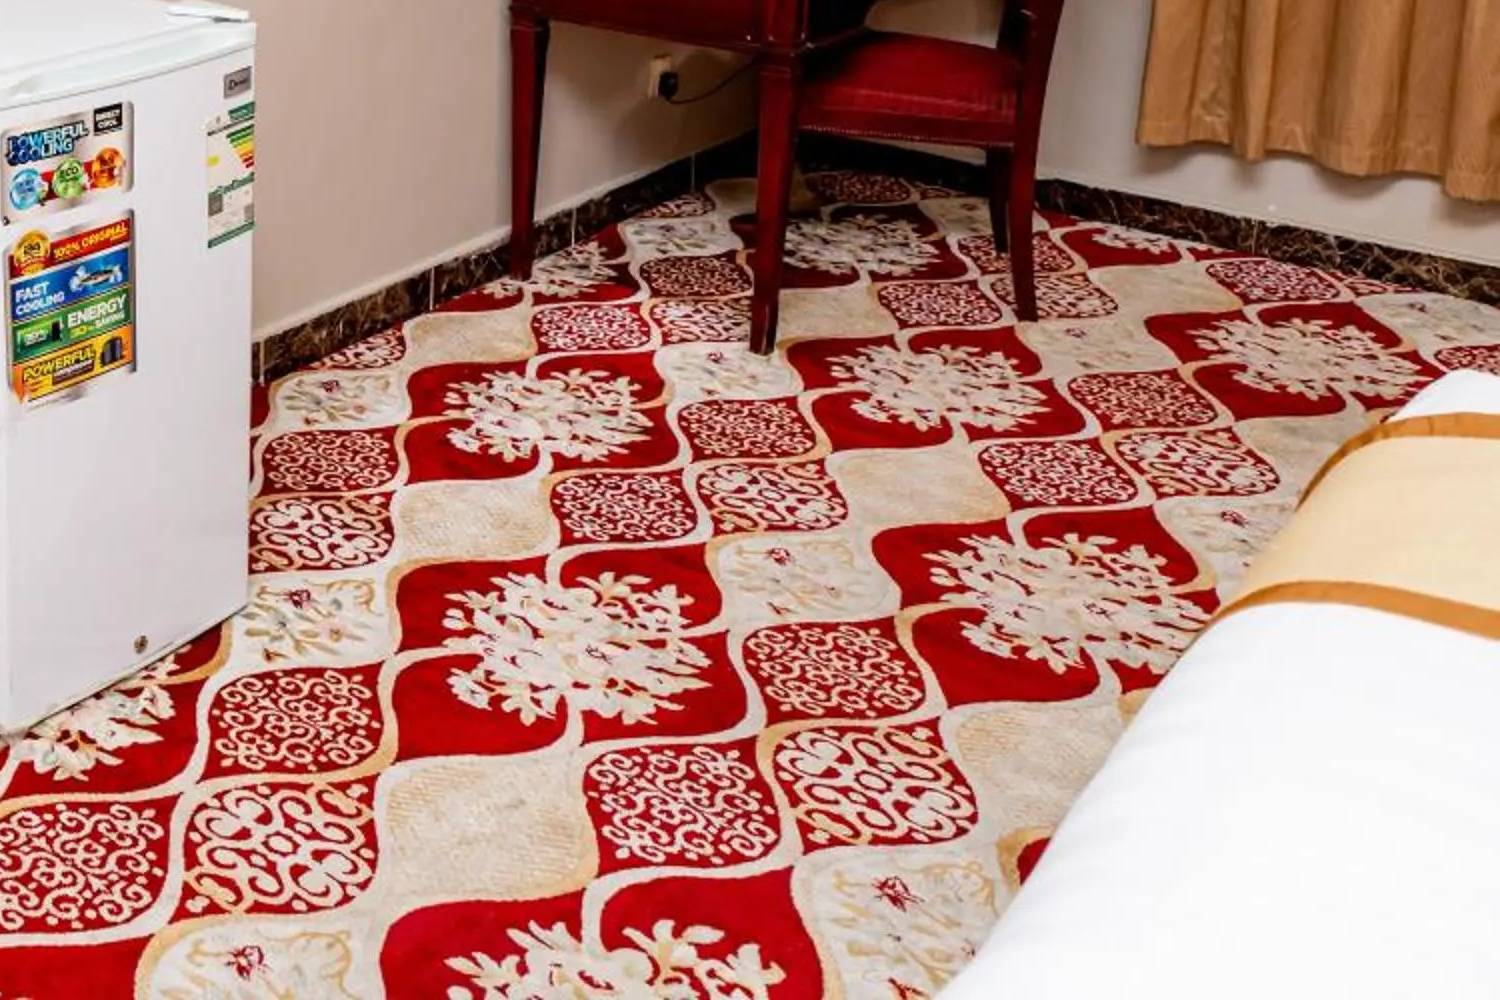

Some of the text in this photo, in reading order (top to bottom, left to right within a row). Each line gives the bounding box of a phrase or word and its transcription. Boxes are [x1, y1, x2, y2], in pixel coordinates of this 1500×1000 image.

[7, 122, 86, 153] POWERFUL
[8, 137, 74, 164] COOLING
[82, 222, 128, 247] ORIGINAL
[15, 281, 50, 303] FAST
[16, 291, 65, 316] COOLING
[67, 293, 127, 328] ENERGY
[23, 347, 95, 382] POWERFUL
